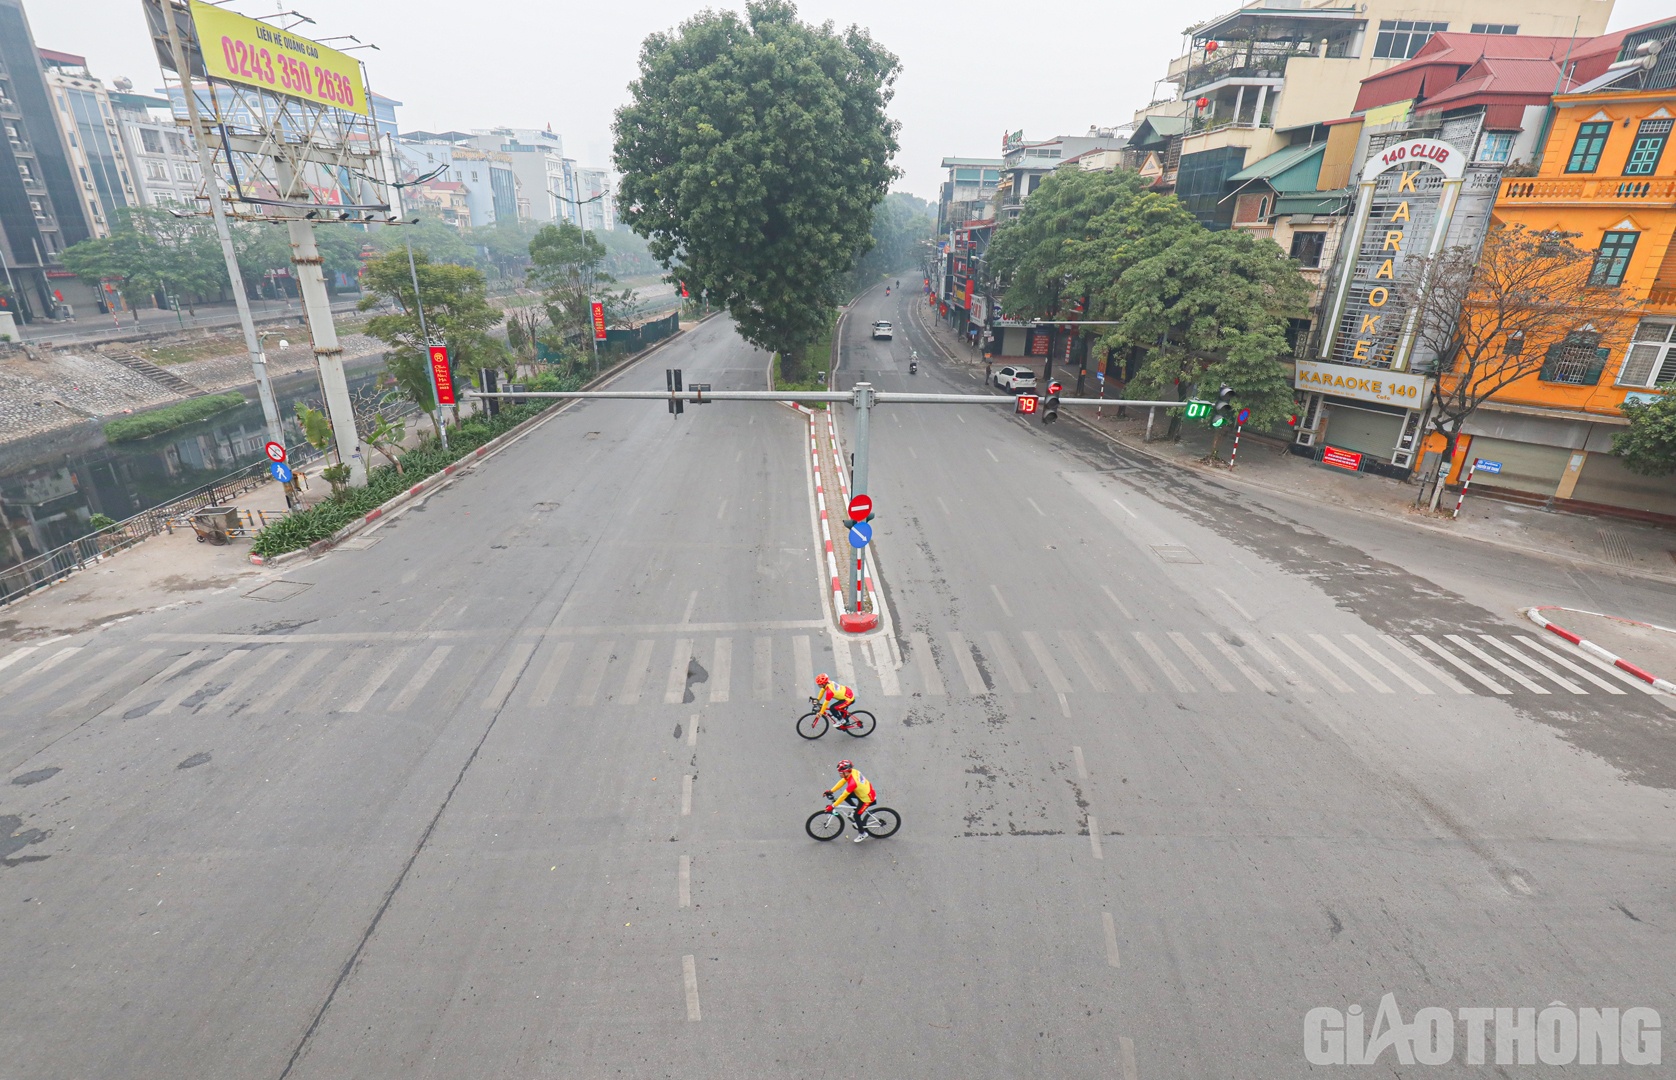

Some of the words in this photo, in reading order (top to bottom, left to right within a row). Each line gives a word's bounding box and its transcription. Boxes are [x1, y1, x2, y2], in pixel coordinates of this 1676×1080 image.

[255, 26, 273, 43] LIÊN
[273, 31, 283, 49] HỆ
[221, 35, 275, 85] 0243
[277, 53, 312, 95] 350
[314, 66, 354, 107] 2636
[1382, 146, 1406, 165] 140
[1410, 143, 1450, 163] CLUB
[1352, 170, 1421, 360] KARAOKE
[1300, 370, 1383, 393] KARAOKE
[1388, 383, 1417, 399] 140
[1019, 398, 1034, 412] 79
[1187, 403, 1206, 417] 01
